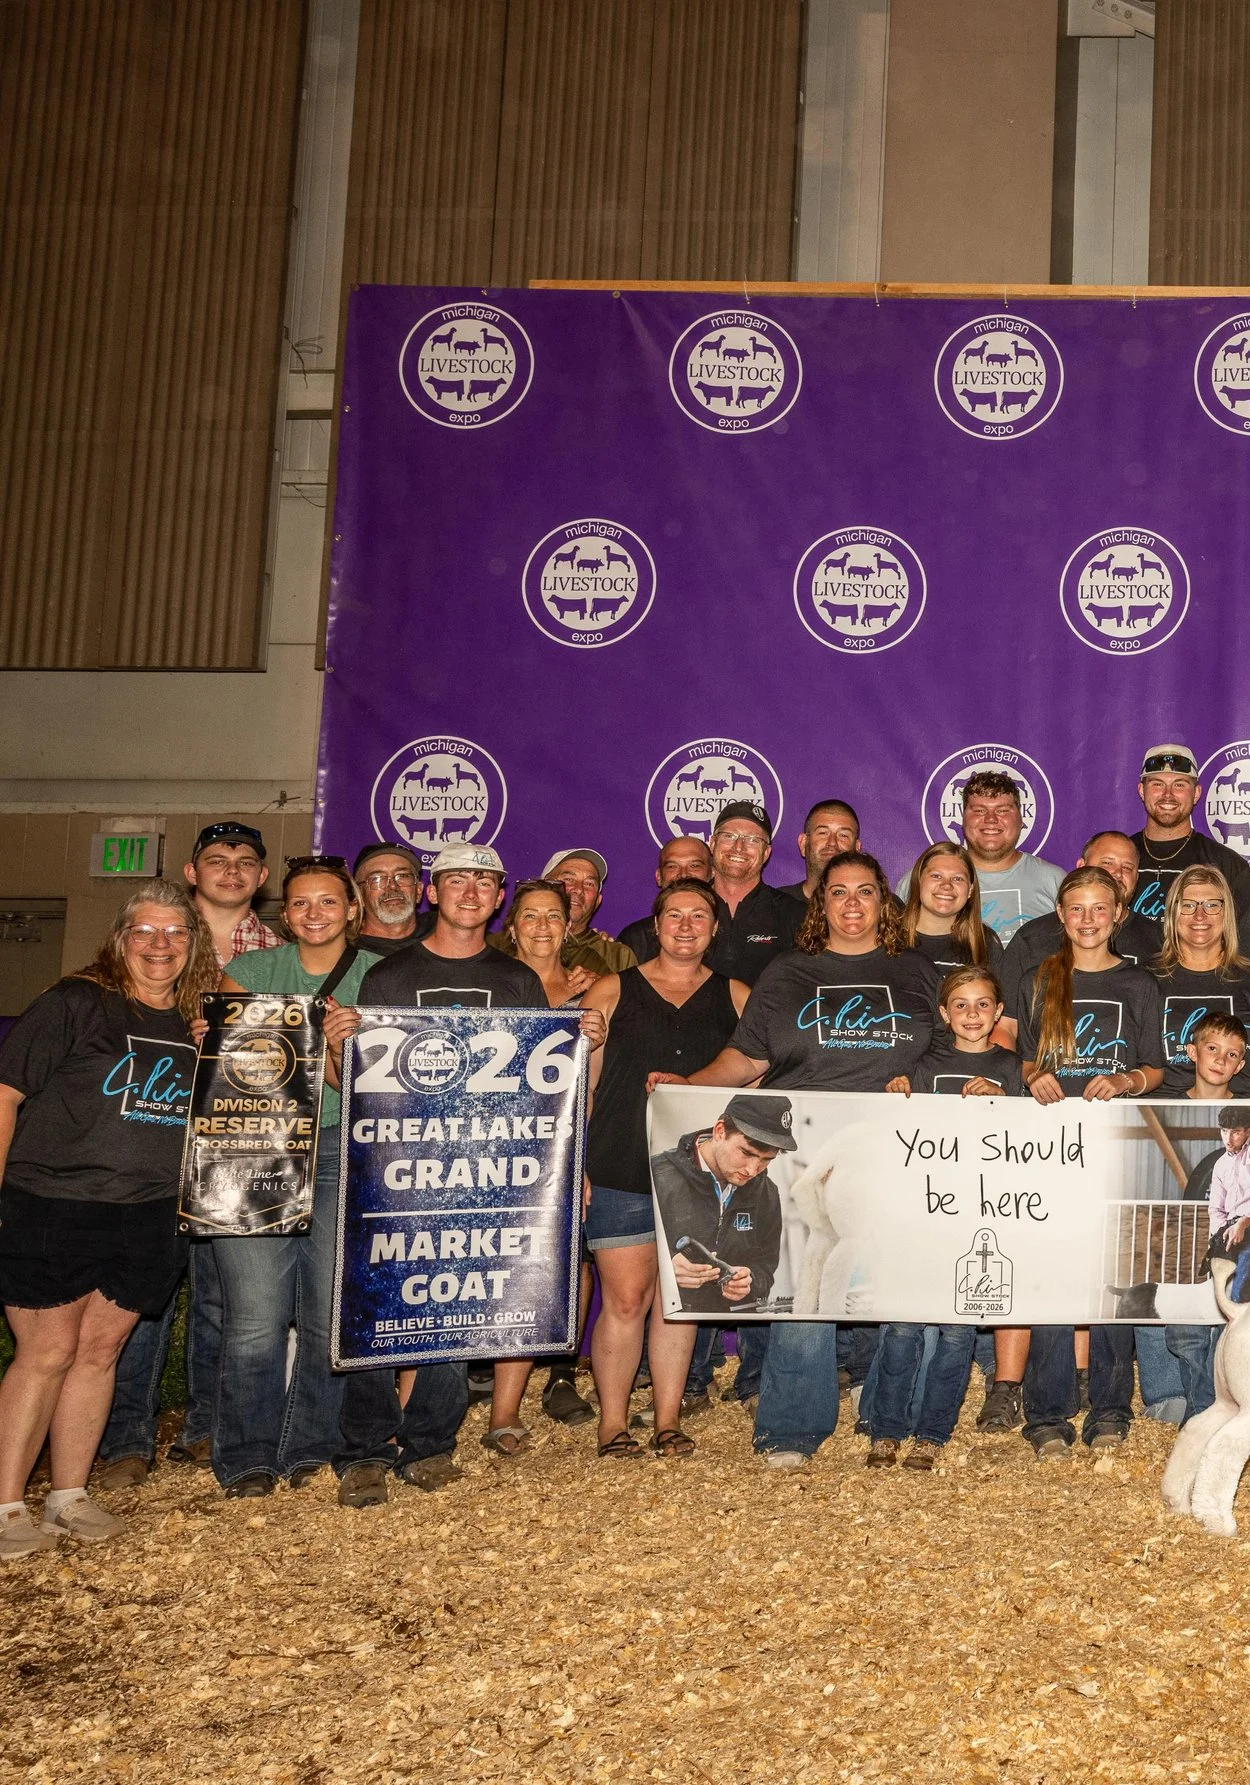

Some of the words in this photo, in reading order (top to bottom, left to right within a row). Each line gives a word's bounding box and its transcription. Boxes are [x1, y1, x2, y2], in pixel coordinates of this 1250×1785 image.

[442, 307, 500, 322] michigan
[711, 316, 768, 331] michigan
[974, 320, 1029, 334] michigan
[421, 359, 512, 373] LIVESTOCK
[690, 364, 781, 382] LIVESTOCK
[955, 372, 1043, 385] LIVESTOCK
[449, 414, 480, 426] expo
[718, 419, 749, 431] expo
[984, 425, 1015, 437] expo
[565, 524, 622, 539] michigan
[836, 530, 892, 546] michigan
[1100, 530, 1155, 546] michigan
[543, 577, 635, 591] LIVESTOCK
[815, 582, 906, 598] LIVESTOCK
[1080, 585, 1170, 598] LIVESTOCK
[572, 633, 603, 645] expo
[844, 638, 875, 650] expo
[1110, 640, 1141, 652] expo
[414, 741, 472, 756] michigan
[689, 742, 747, 759] michigan
[962, 750, 1018, 764] michigan
[392, 796, 485, 811] LIVESTOCK
[666, 797, 762, 813] LIVEST
[103, 837, 148, 872] EXIT
[421, 853, 436, 863] ex
[224, 1001, 303, 1027] 2026
[830, 1029, 868, 1037] SHOW
[872, 1031, 913, 1041] STOCK
[409, 1058, 459, 1067] LIVESTOCK
[135, 1100, 172, 1112] SHOW
[213, 1099, 283, 1112] DIVISION
[287, 1100, 298, 1112] 2
[194, 1116, 313, 1135] RESERVE
[353, 1117, 465, 1143] GREAT
[472, 1115, 573, 1141] LAKES
[192, 1140, 271, 1150] CROSSBRED
[274, 1140, 312, 1150] GOAT
[896, 1128, 958, 1167] You
[246, 1168, 279, 1181] Line
[384, 1156, 541, 1191] GRAND
[198, 1182, 297, 1191] CRYOGENICS
[926, 1174, 959, 1215] be
[980, 1173, 1048, 1221] here
[370, 1226, 549, 1264] MARKET
[402, 1271, 510, 1305] GOAT
[963, 1303, 1004, 1311] 2006-2026
[375, 1317, 434, 1333] BELIEVE
[443, 1313, 485, 1327] BUILD
[494, 1311, 536, 1325] GROW
[371, 1338, 394, 1349] OUR
[398, 1335, 435, 1347] YOUTH,
[438, 1332, 463, 1342] OUR
[463, 1328, 539, 1341] AGRICULTURE
